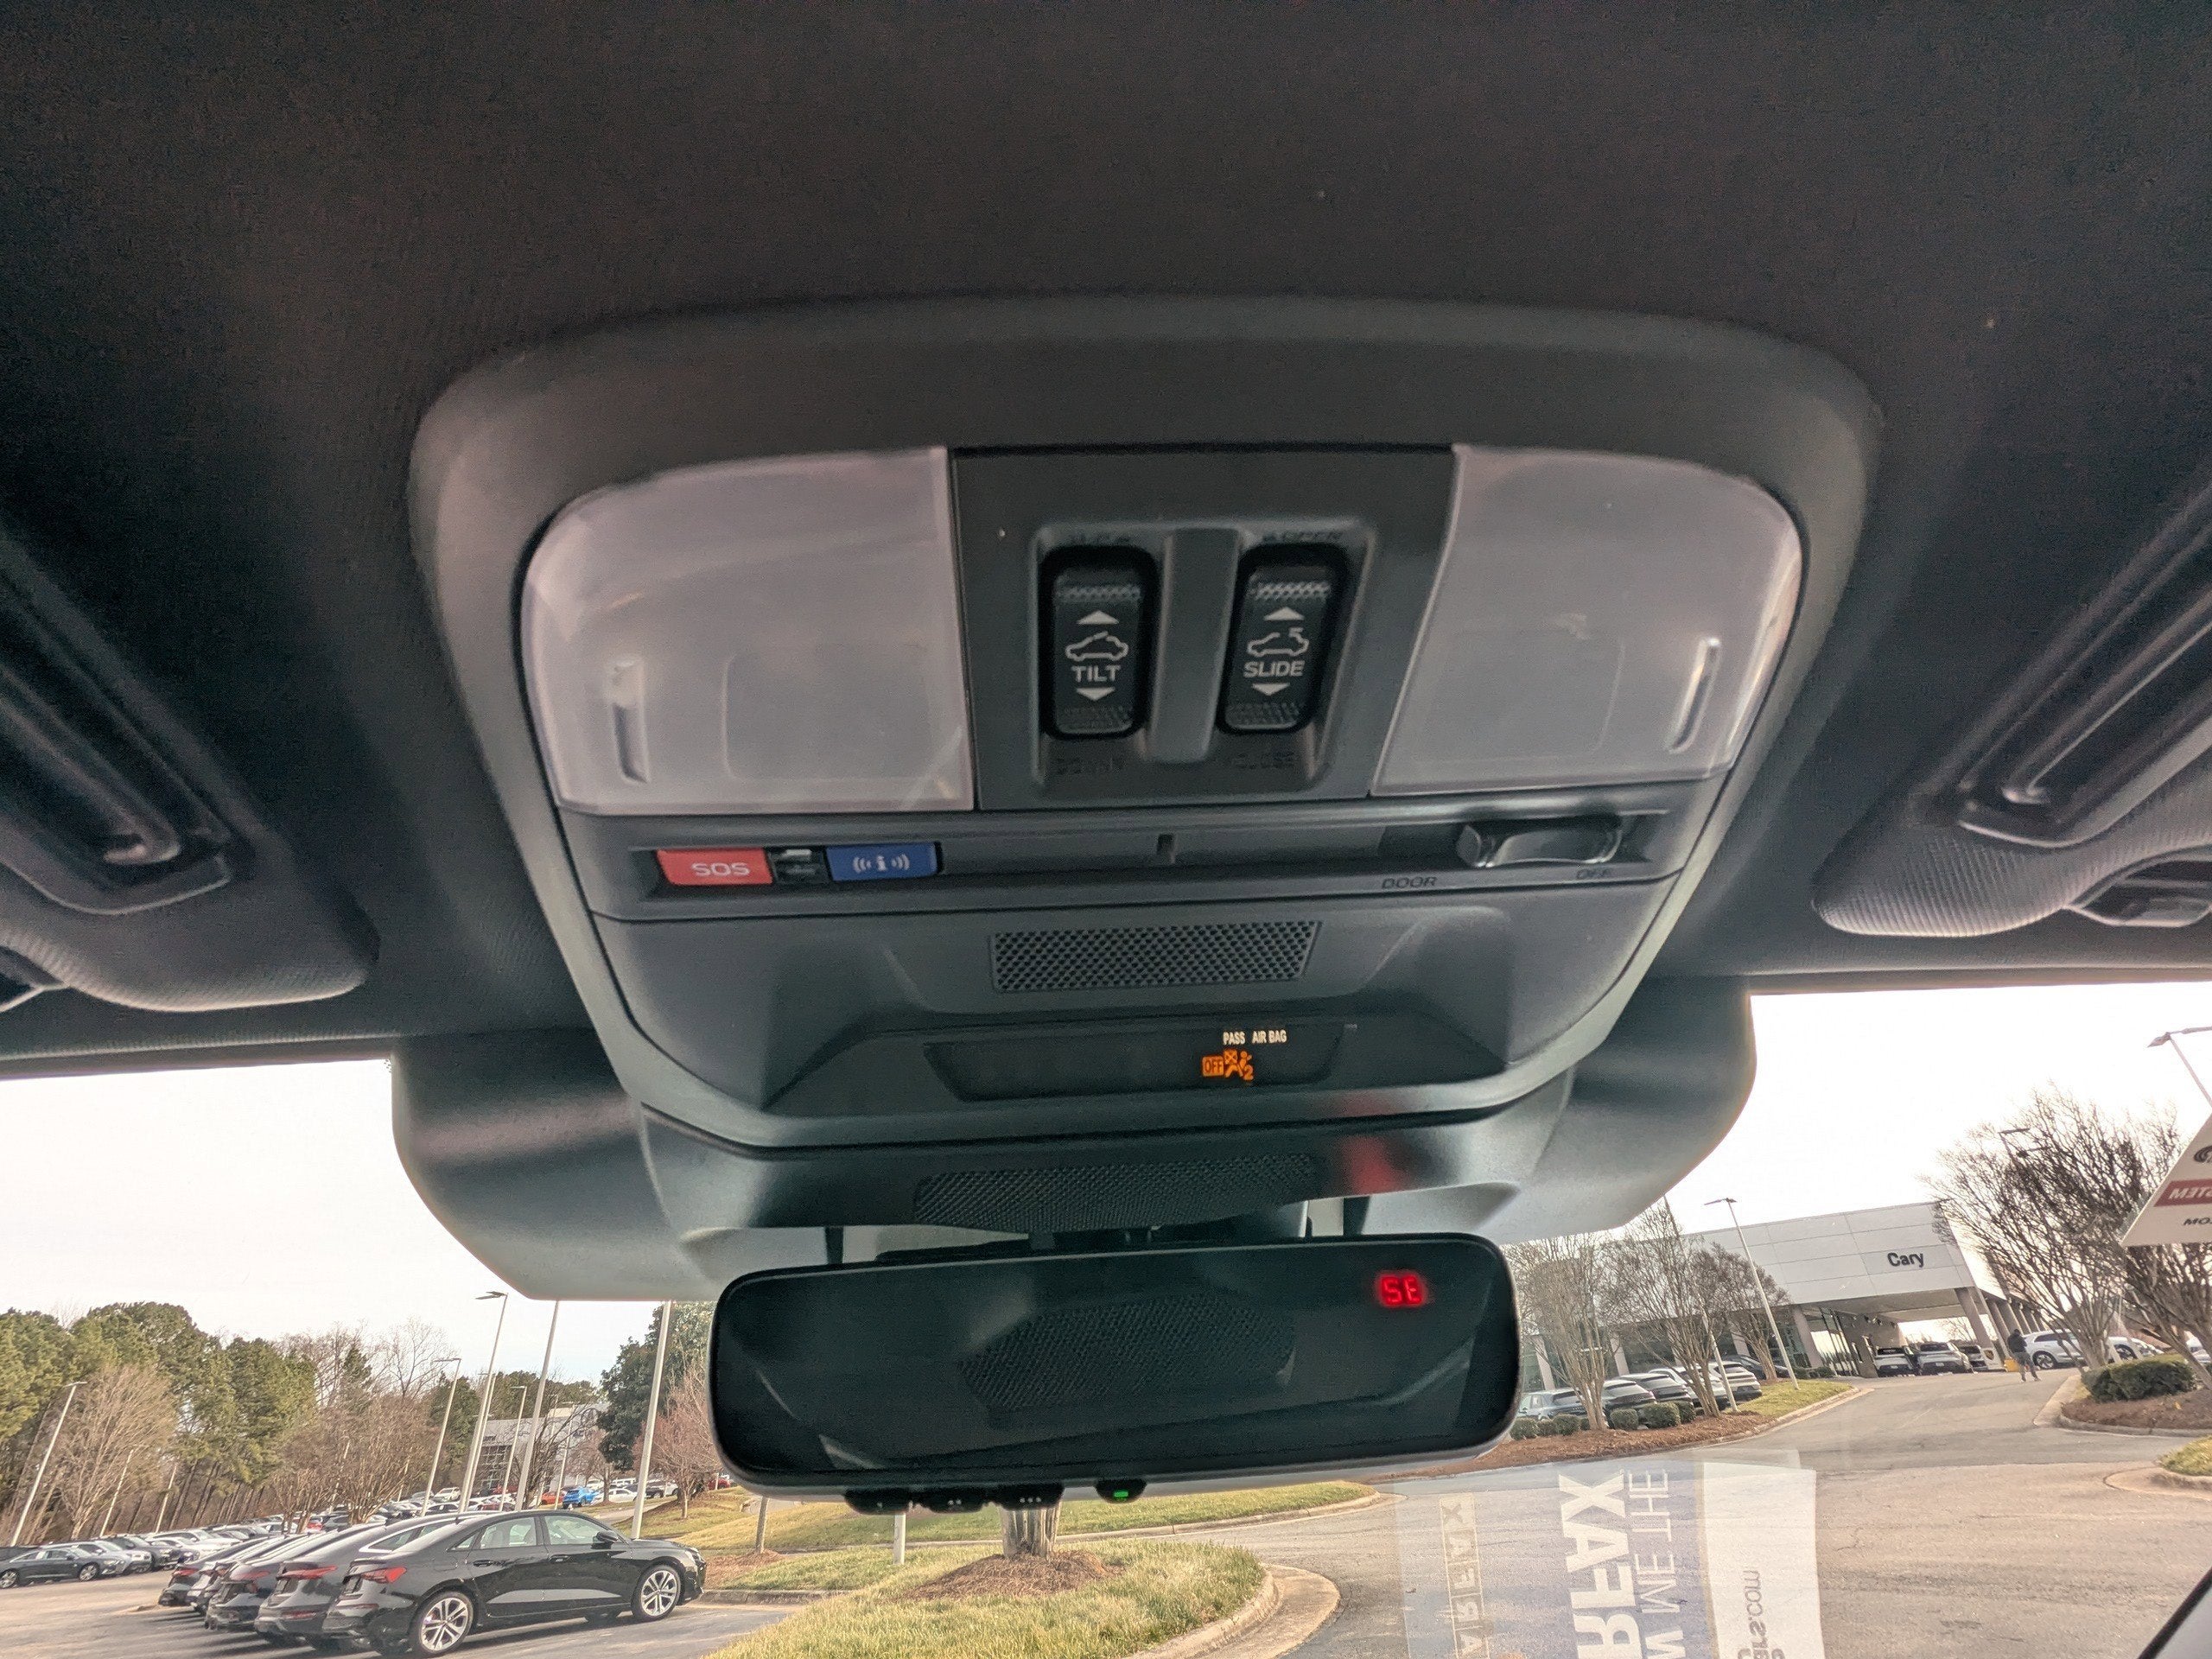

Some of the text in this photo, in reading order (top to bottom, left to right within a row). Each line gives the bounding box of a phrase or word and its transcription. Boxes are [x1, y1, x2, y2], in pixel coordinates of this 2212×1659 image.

[1071, 664, 1122, 683] TILT
[1243, 661, 1305, 677] SLIDE
[691, 861, 751, 877] SOS
[1382, 875, 1438, 890] DOOR
[1223, 1029, 1287, 1046] PASS AIR BAG
[1204, 1058, 1223, 1074] OFF
[1887, 1251, 1925, 1268] Cary
[1382, 1274, 1422, 1306] SE
